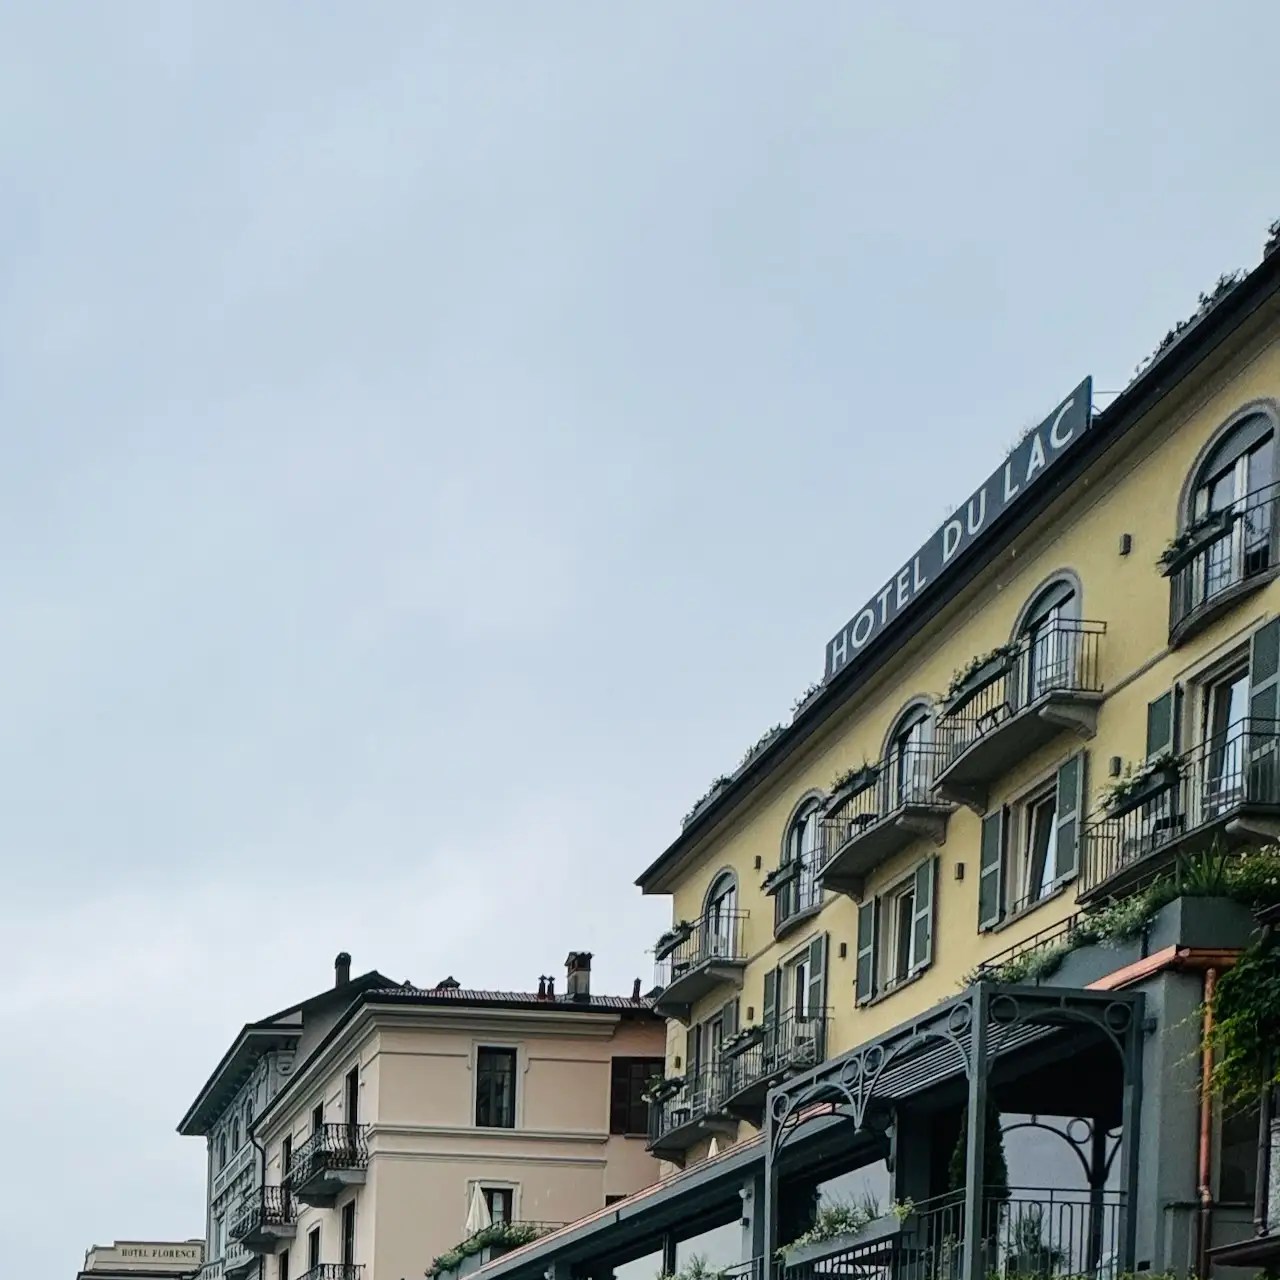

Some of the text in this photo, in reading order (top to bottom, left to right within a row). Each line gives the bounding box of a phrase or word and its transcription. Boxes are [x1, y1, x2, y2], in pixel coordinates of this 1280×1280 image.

[831, 397, 1075, 673] HOTEL DU LAC
[121, 1248, 197, 1258] HOTEL FLORENCE
